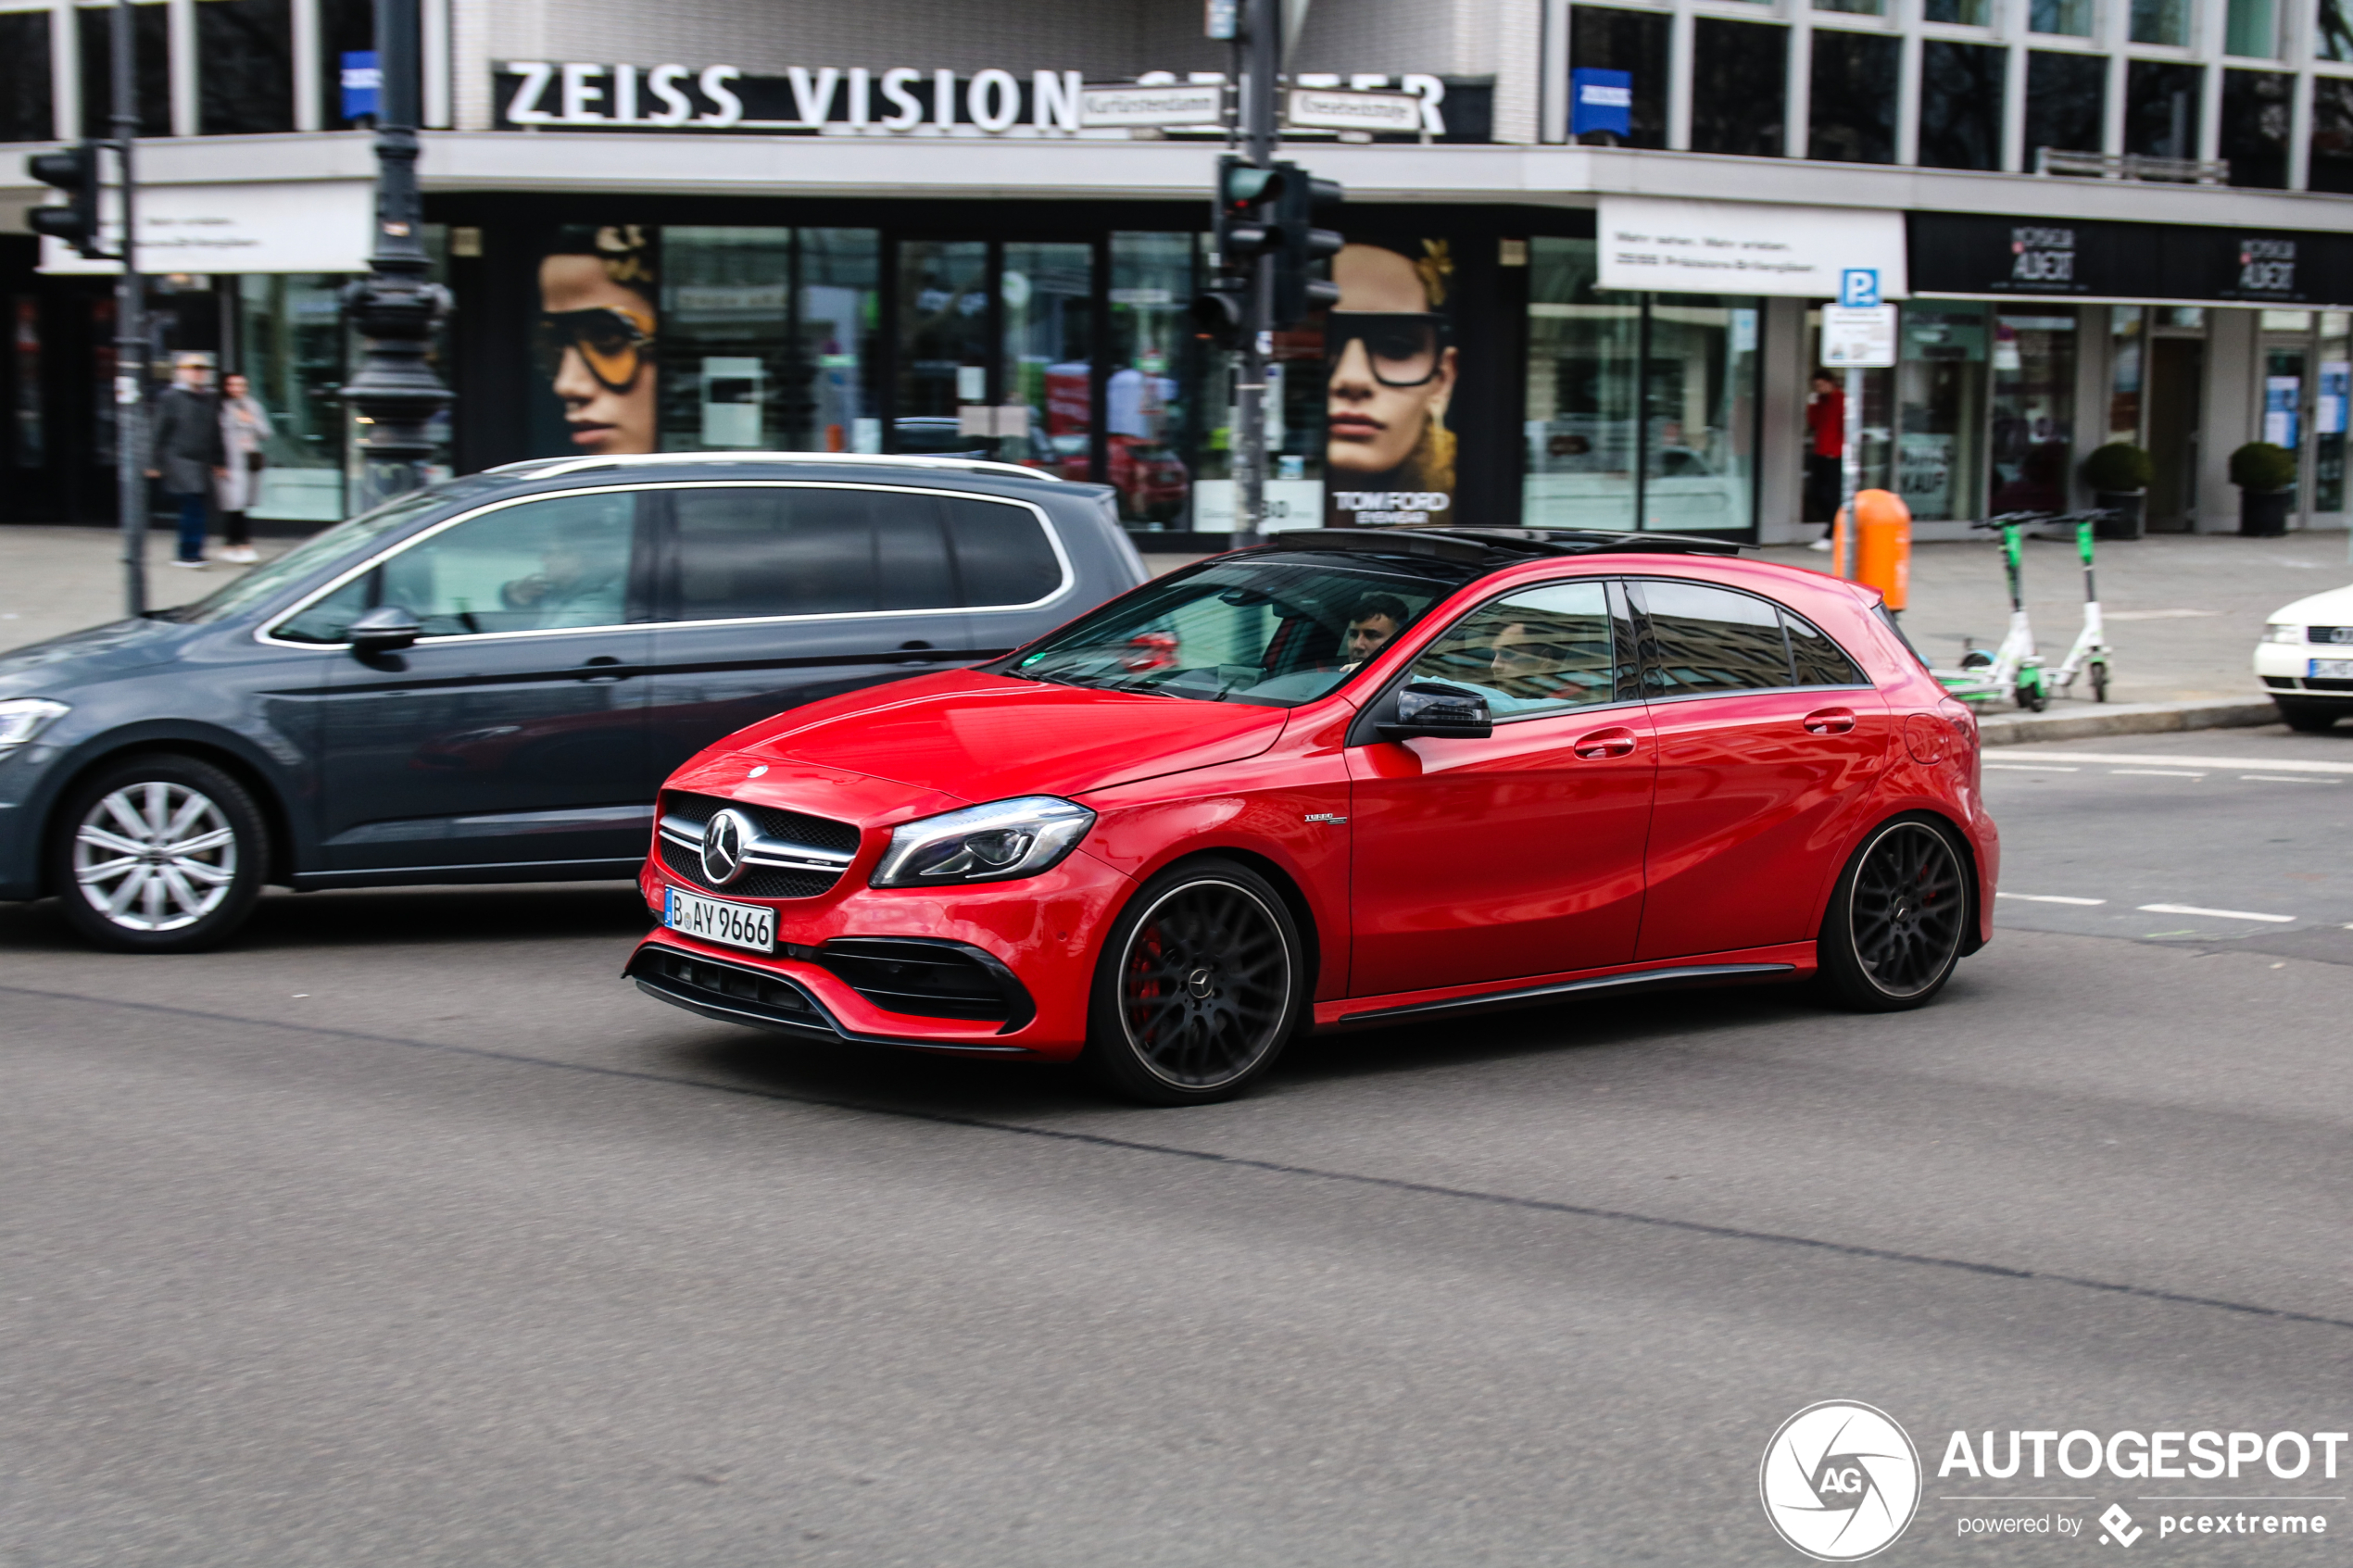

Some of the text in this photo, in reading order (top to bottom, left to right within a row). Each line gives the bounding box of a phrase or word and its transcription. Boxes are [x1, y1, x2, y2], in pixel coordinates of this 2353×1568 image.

[507, 62, 1082, 134] ZEISS VISION
[1846, 271, 1874, 305] P
[1332, 492, 1451, 511] TOM FORD
[673, 895, 770, 946] B AY 9666
